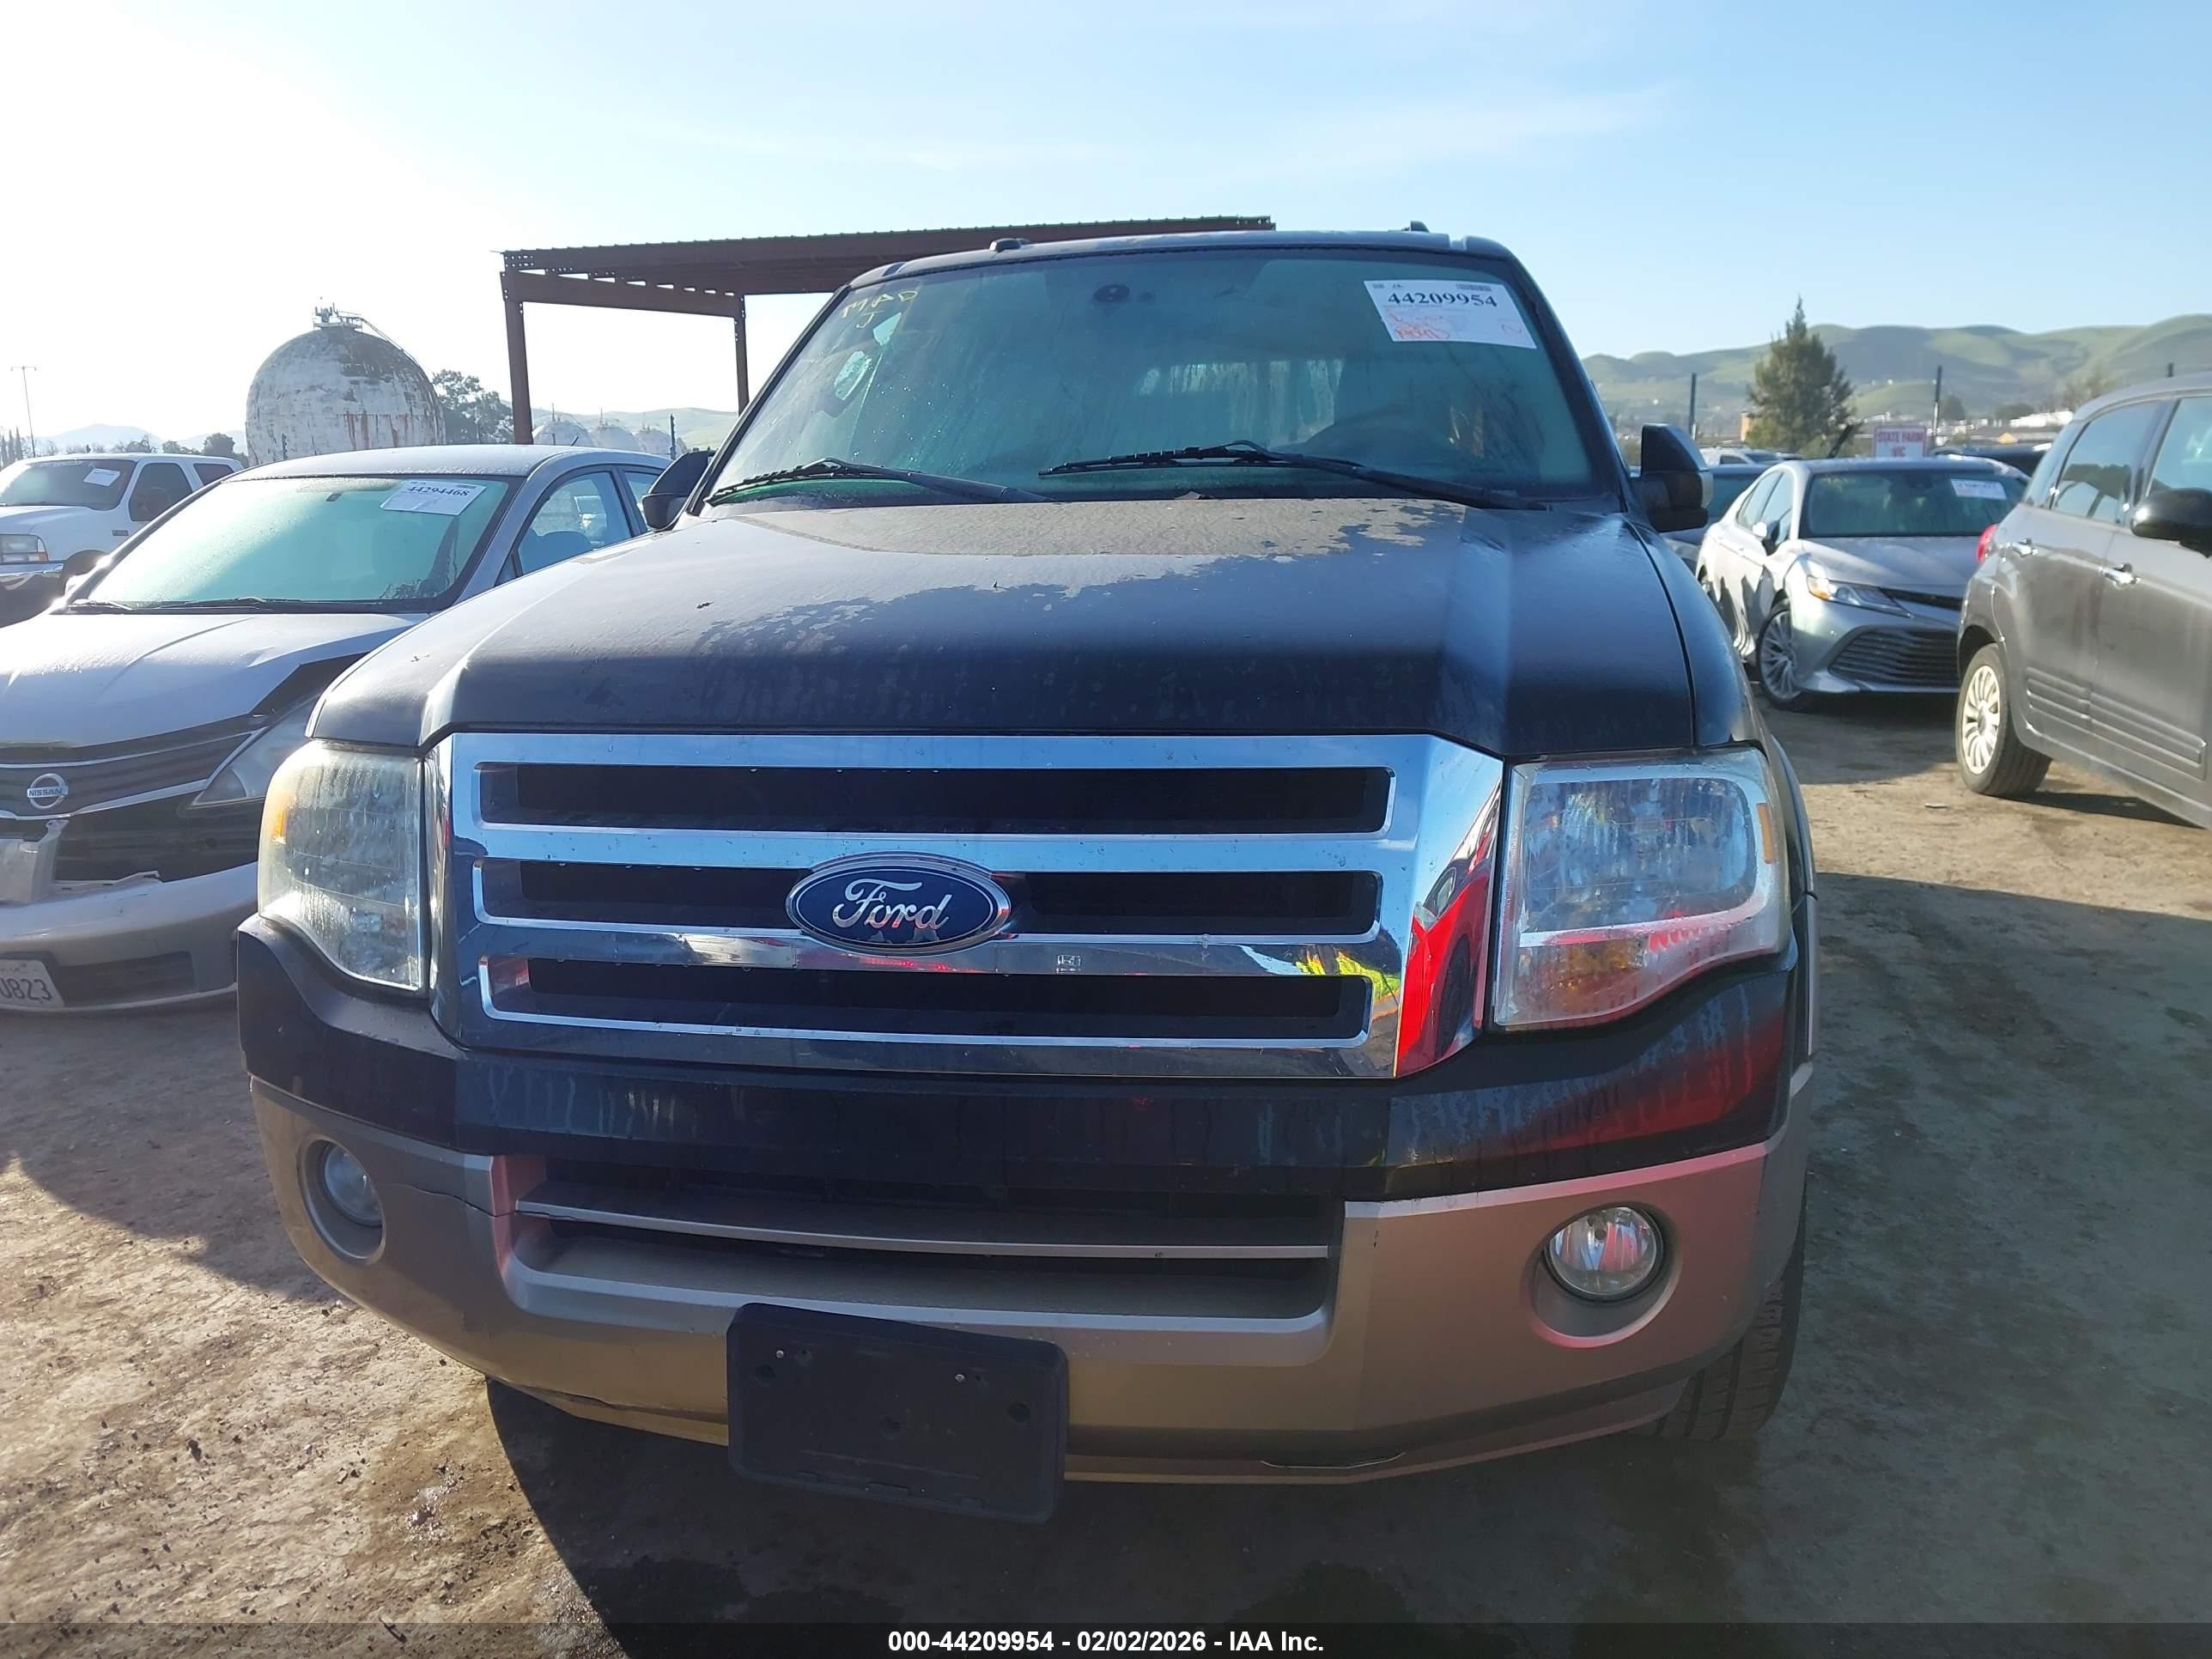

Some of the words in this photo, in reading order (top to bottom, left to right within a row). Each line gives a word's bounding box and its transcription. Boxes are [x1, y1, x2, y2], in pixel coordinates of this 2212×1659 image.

[1388, 291, 1498, 307] 44209954
[407, 485, 471, 497] 44294468
[28, 788, 64, 797] NISSAN
[832, 878, 952, 929] Ford
